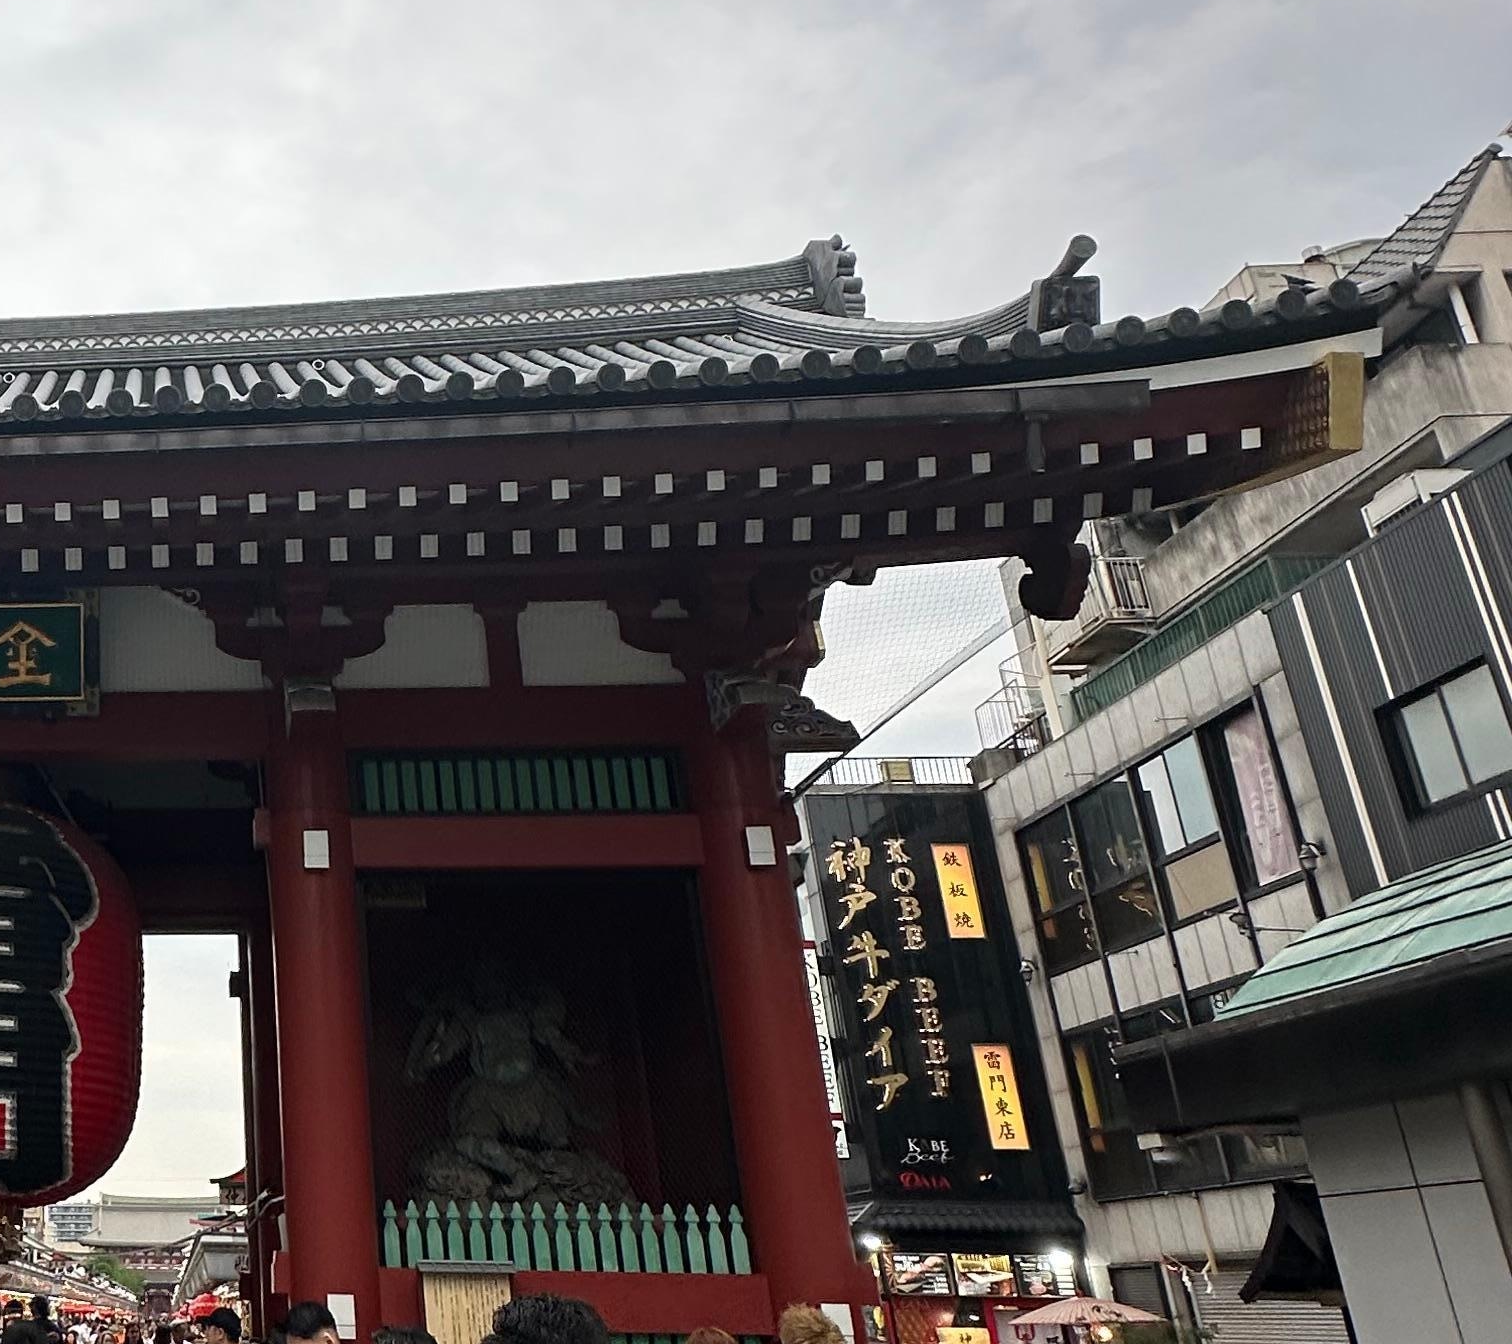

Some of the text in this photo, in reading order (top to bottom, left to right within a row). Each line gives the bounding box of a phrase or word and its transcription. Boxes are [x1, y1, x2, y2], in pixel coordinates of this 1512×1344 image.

[942, 851, 975, 929] 鉄板焼
[825, 836, 909, 1111] 神戸牛ダイア
[883, 838, 951, 1097] KOBE BEEF
[983, 1051, 1017, 1141] 雷門東店
[907, 1138, 950, 1152] KBE
